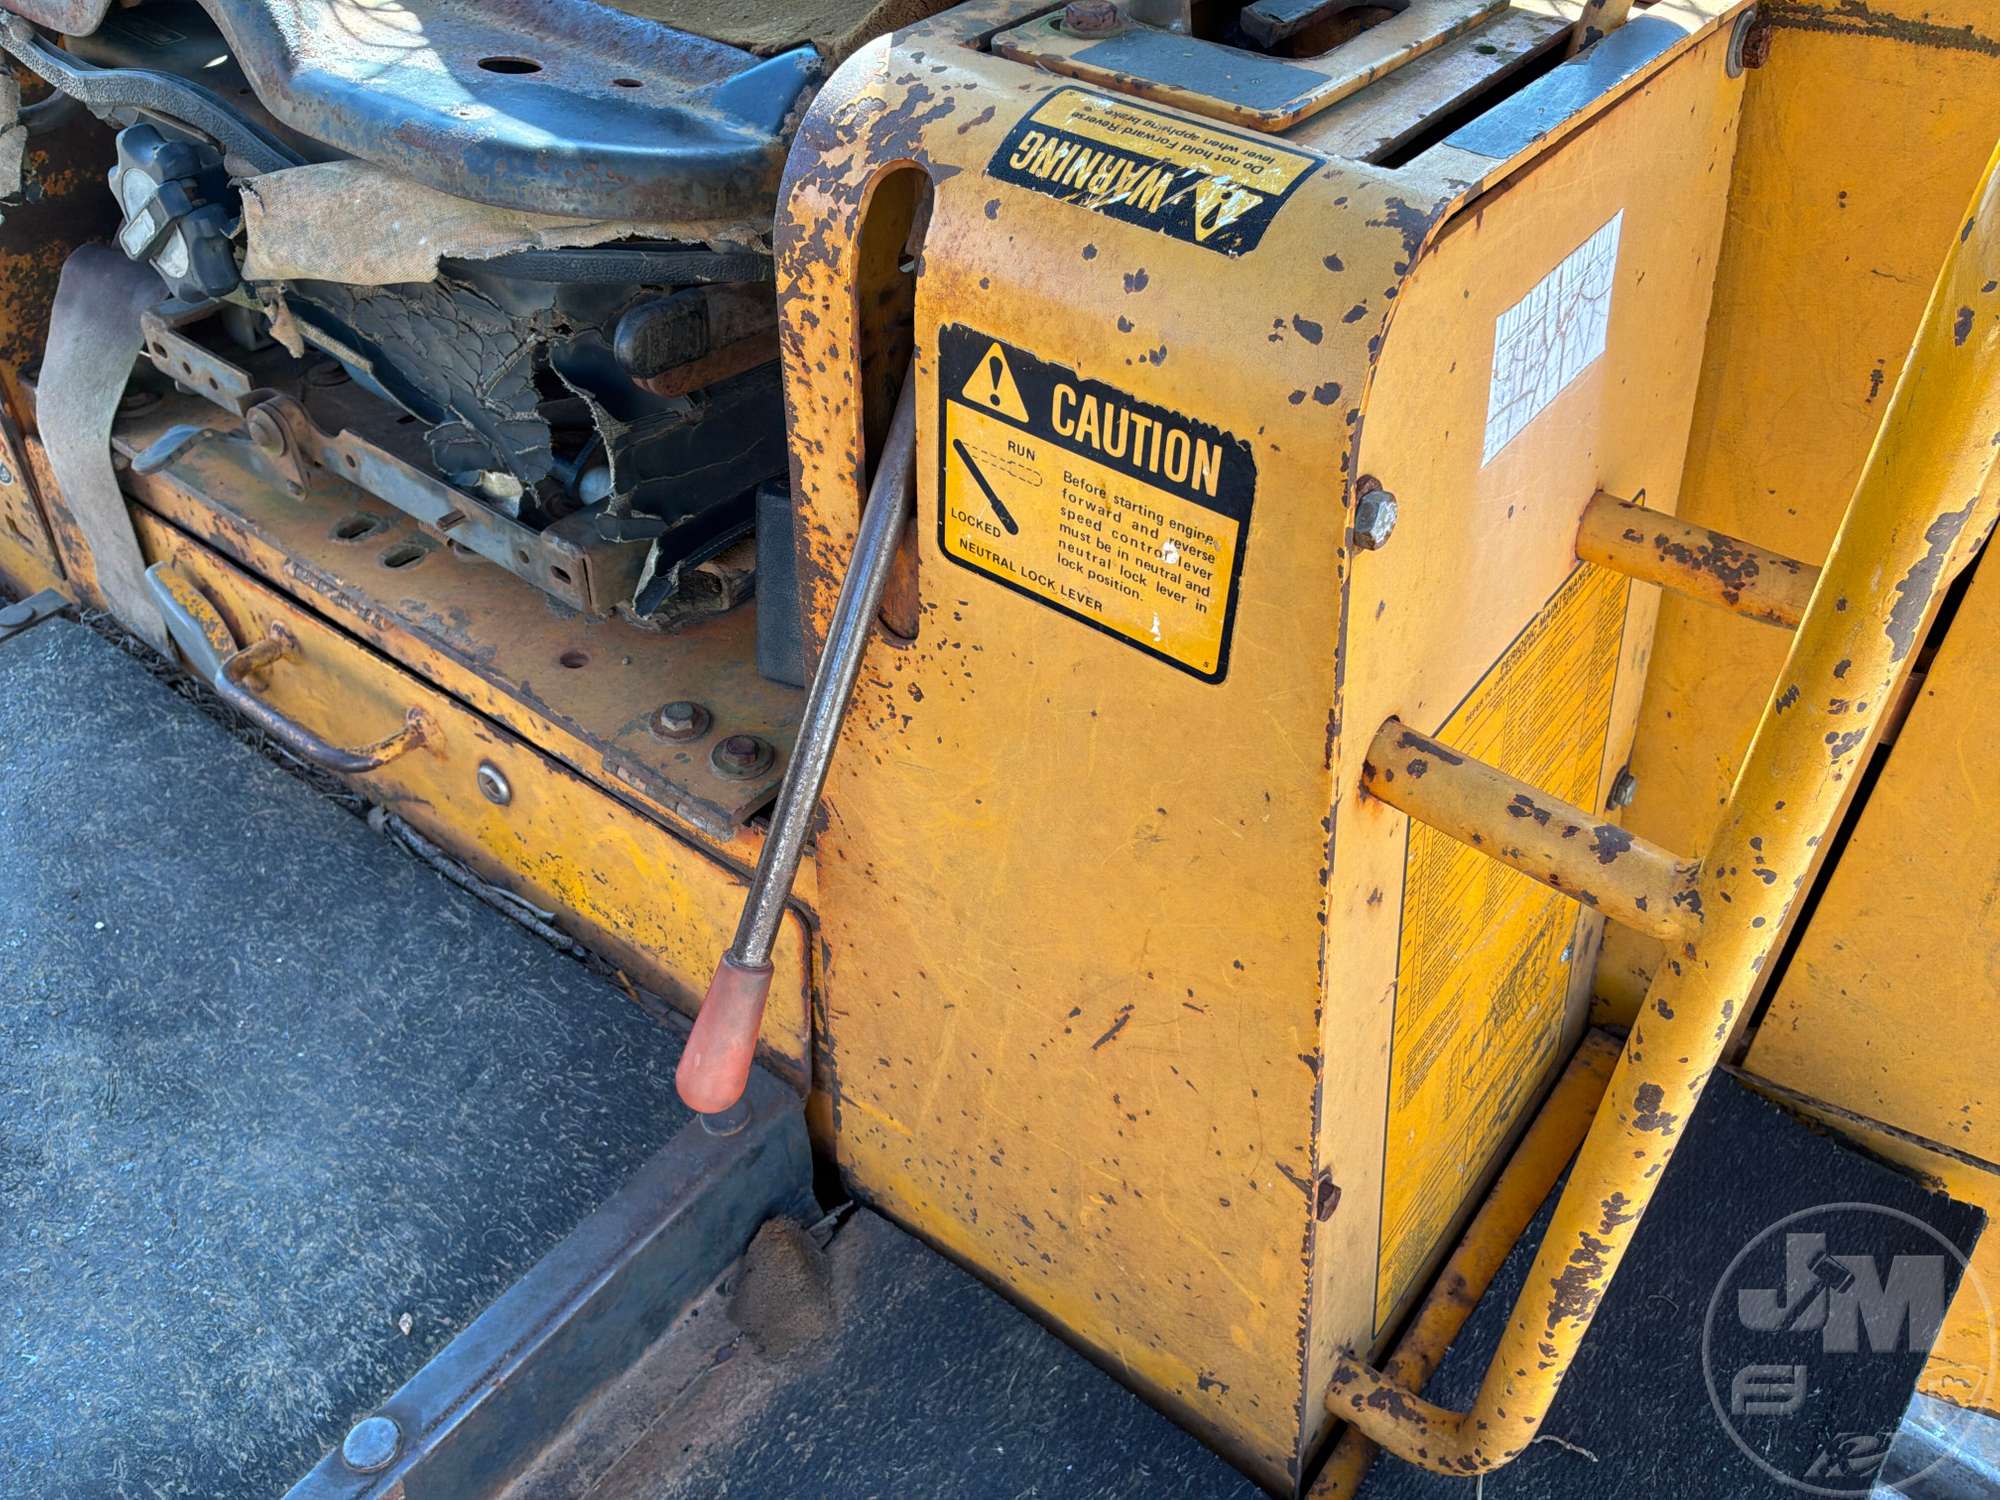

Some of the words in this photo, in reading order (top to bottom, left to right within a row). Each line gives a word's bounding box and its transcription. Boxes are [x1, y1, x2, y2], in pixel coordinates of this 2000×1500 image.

[1142, 120, 1200, 141] applying
[1180, 144, 1214, 160] hold
[1202, 138, 1239, 153] when
[1009, 130, 1175, 213] WARNING
[1214, 154, 1240, 166] not
[1241, 149, 1276, 165] lever
[1243, 162, 1265, 175] Do
[1008, 440, 1036, 462] RUN
[1051, 384, 1223, 497] CAUTION
[951, 507, 1001, 538] LOCKED
[1063, 470, 1107, 499] Before
[1113, 494, 1164, 526] starting
[1060, 506, 1102, 532] speed
[1177, 556, 1214, 581] lever
[1062, 488, 1122, 523] forward
[1131, 520, 1159, 540] and
[1169, 537, 1216, 564] reverse
[959, 538, 1017, 572] NEUTRAL
[1020, 566, 1056, 591] LOCK
[1060, 584, 1103, 612] LEVER
[1057, 552, 1085, 574] lock
[1087, 568, 1144, 602] position.
[1058, 539, 1111, 570] neutral
[1119, 565, 1148, 586] lock
[1156, 581, 1188, 604] lever
[1195, 599, 1208, 614] in
[1059, 523, 1091, 544] must
[1096, 537, 1112, 553] be
[1117, 547, 1129, 561] in
[1135, 557, 1182, 585] neutral
[1185, 580, 1211, 598] and
